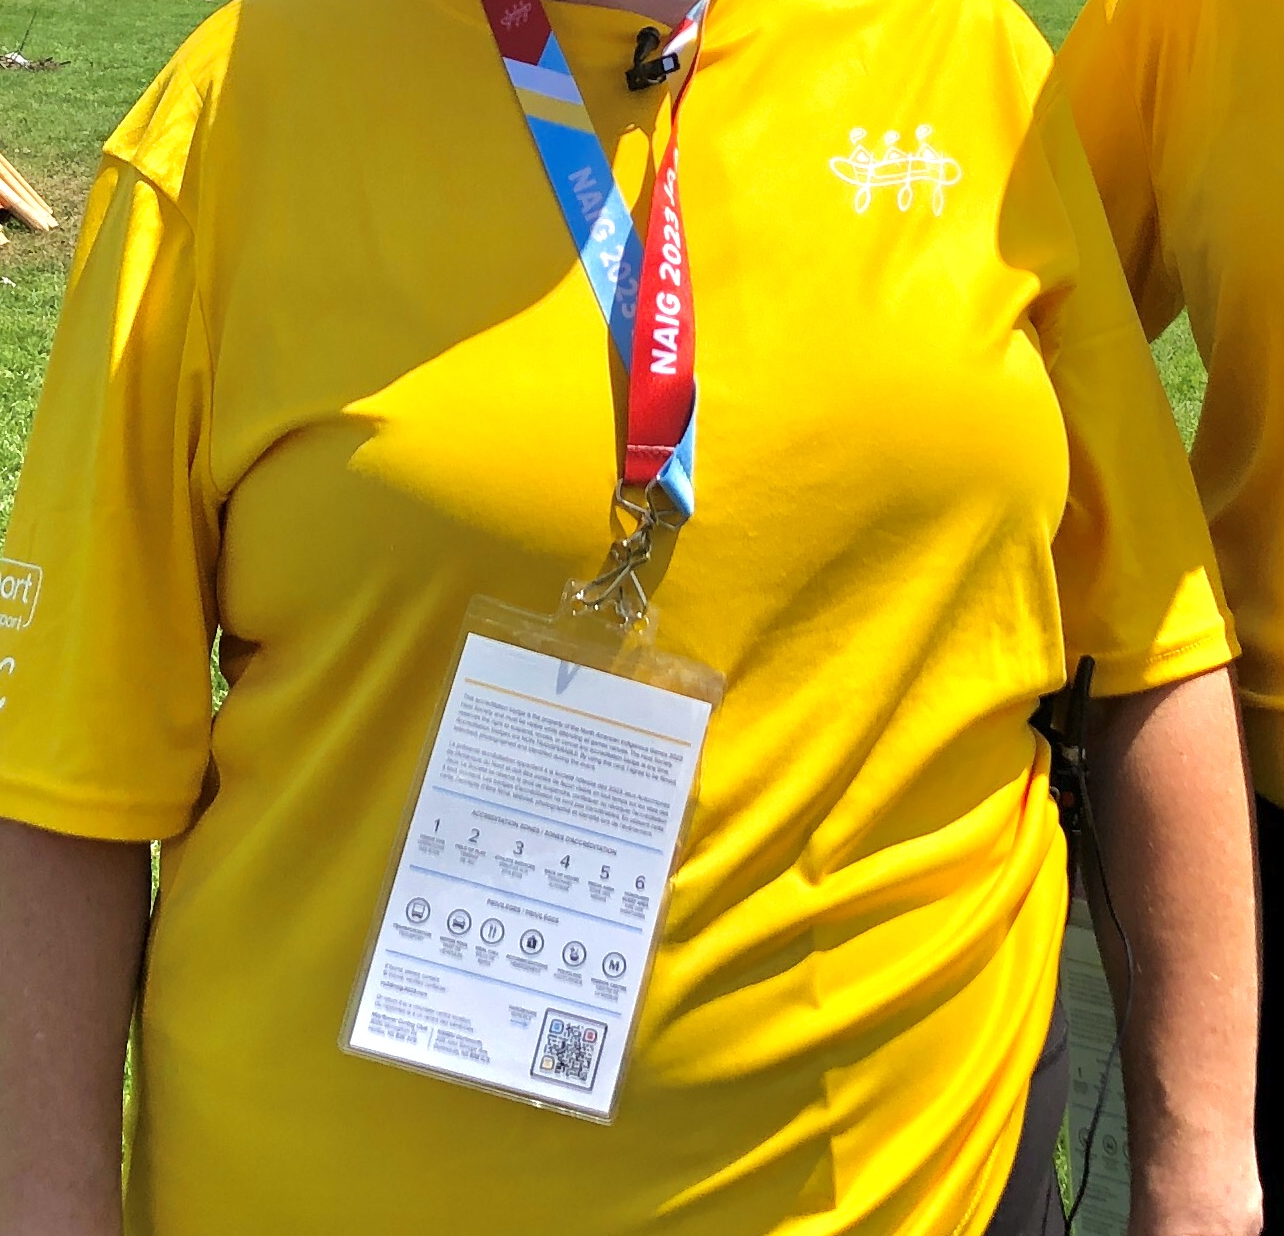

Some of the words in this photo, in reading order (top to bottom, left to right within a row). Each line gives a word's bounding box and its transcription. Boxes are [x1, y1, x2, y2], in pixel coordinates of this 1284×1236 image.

[568, 167, 615, 242] NAIG
[659, 206, 681, 286] 2023
[650, 292, 681, 374] NAIG
[434, 818, 441, 833] 1
[468, 828, 480, 844] 2
[513, 840, 525, 856] 3
[560, 854, 571, 869] 4
[600, 864, 611, 880] 5
[635, 875, 646, 890] 6
